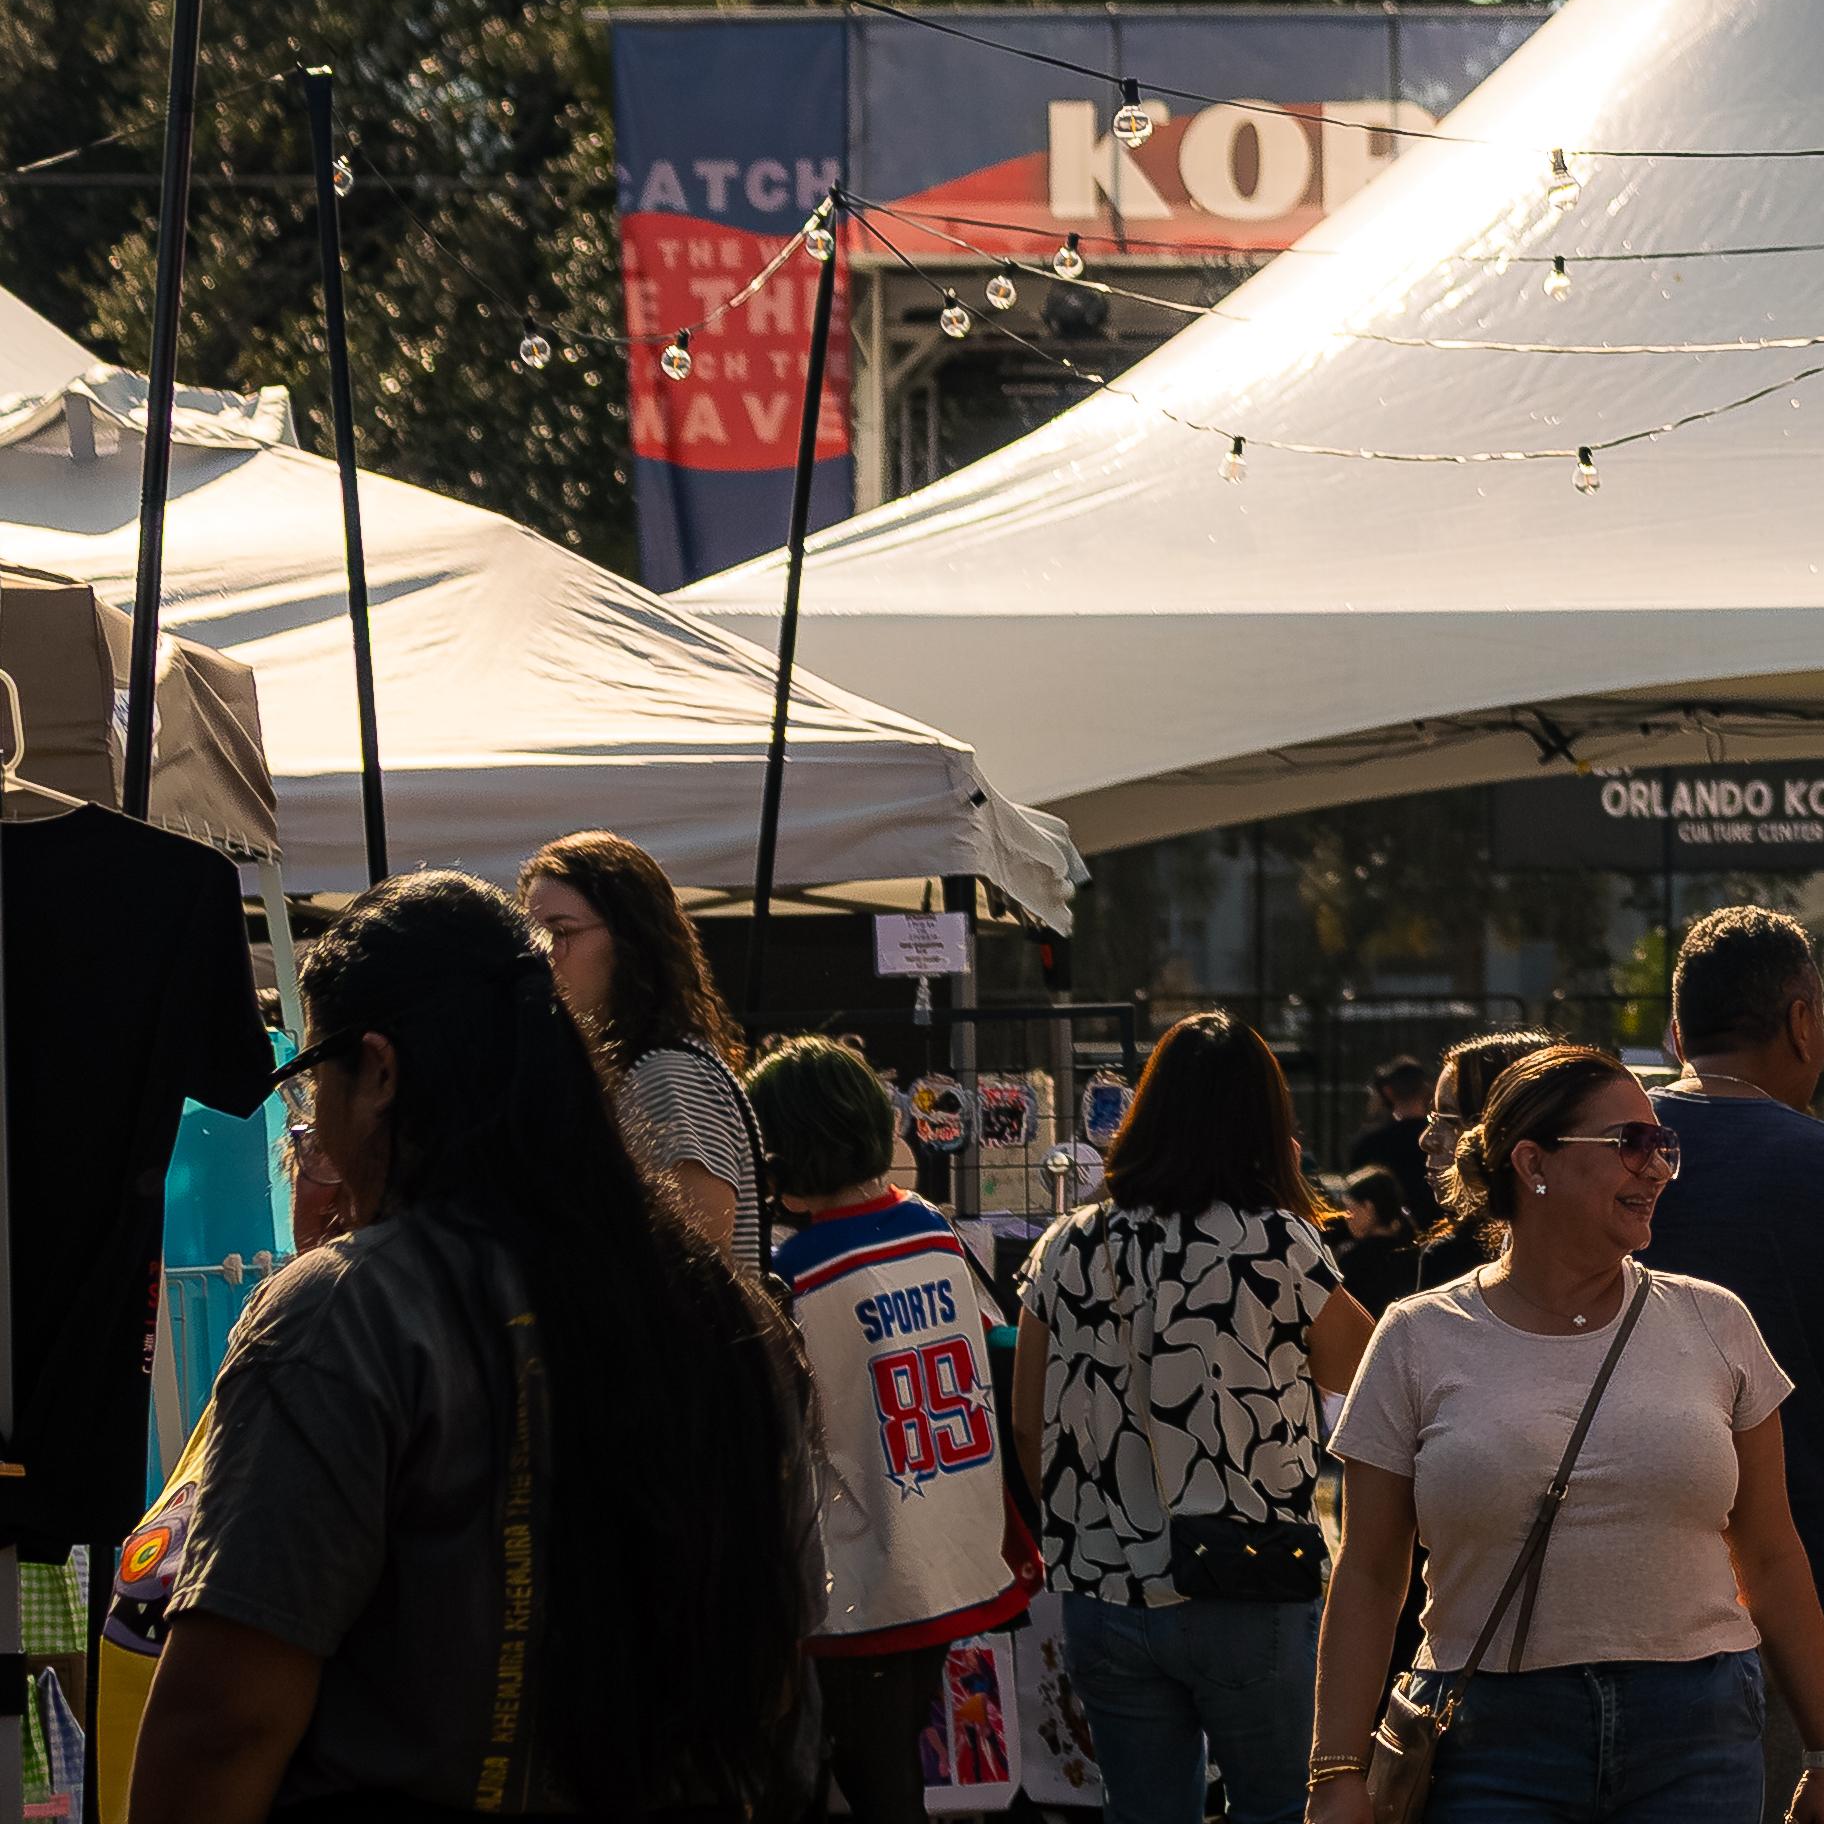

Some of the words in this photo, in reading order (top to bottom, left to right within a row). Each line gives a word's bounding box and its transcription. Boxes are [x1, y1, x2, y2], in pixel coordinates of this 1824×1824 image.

[657, 238, 743, 271] THE
[1601, 778, 1774, 818] ORLANDO
[855, 1278, 957, 1344] SPORTS
